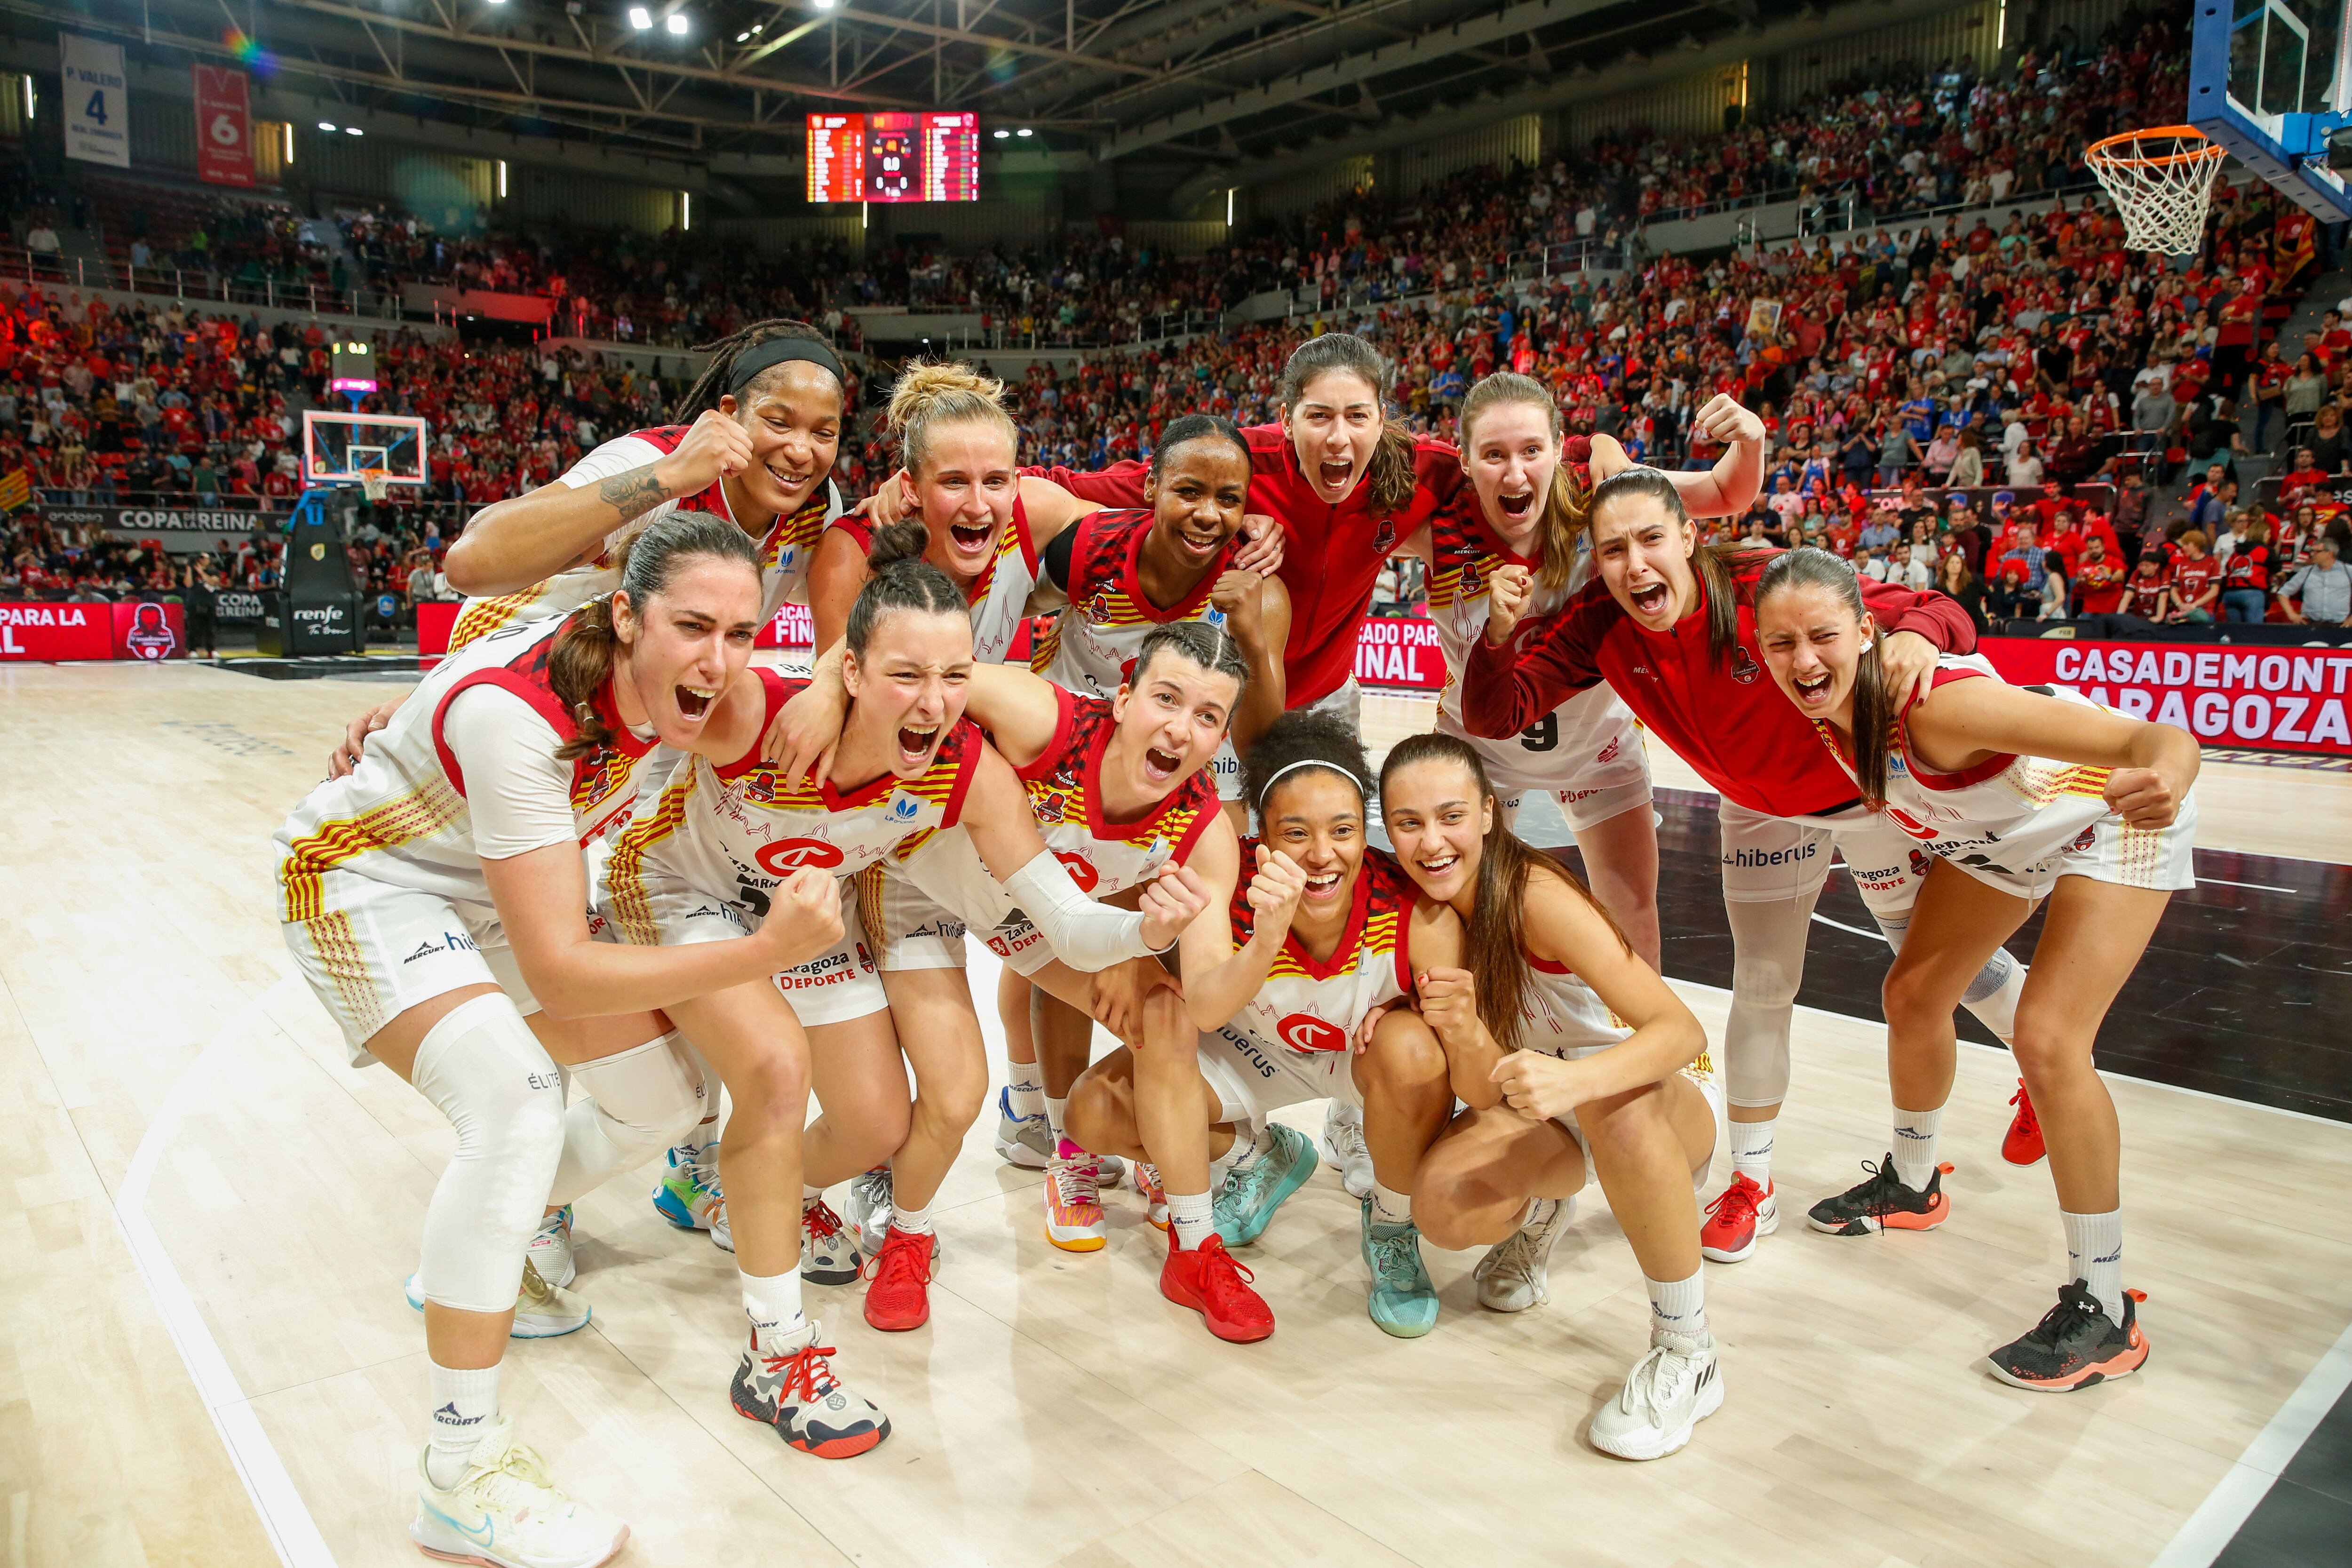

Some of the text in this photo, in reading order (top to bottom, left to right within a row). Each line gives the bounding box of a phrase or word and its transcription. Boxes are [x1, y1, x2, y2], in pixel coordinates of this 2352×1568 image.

[79, 70, 122, 89] VALERO
[86, 90, 108, 125] 4
[211, 114, 239, 145] 6
[48, 511, 103, 523] endesa
[119, 509, 183, 530] COPA
[197, 512, 257, 531] REINA
[218, 594, 262, 606] COPA
[59, 609, 87, 626] LA
[226, 606, 264, 617] REINA
[294, 605, 343, 624] renfe
[2056, 647, 2352, 694] CASADEMONT
[1521, 709, 1558, 752] 9
[1736, 843, 1815, 867] hiberus
[905, 930, 937, 939] MERCURY
[404, 945, 445, 964] MERCURY
[780, 968, 856, 990] DEPORTE
